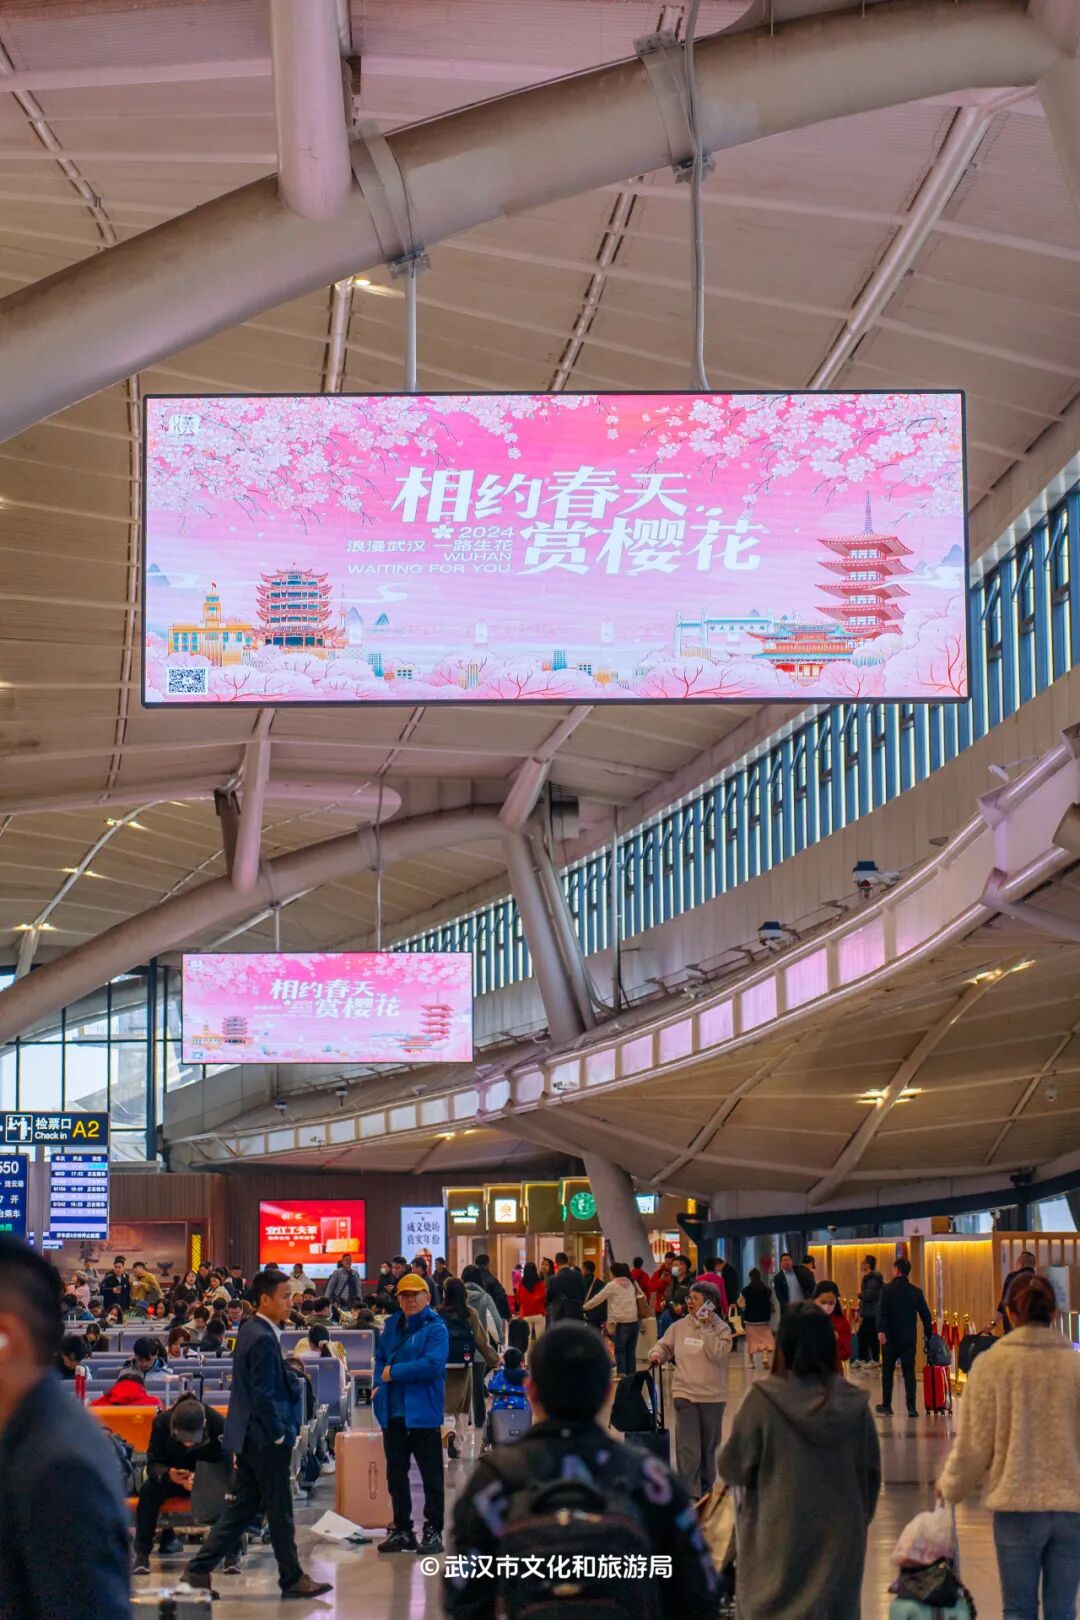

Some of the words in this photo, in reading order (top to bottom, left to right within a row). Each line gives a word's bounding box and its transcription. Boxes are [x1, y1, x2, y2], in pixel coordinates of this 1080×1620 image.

[391, 465, 688, 523] 相约春天
[459, 525, 515, 539] 2024
[347, 539, 426, 553] 浪漫武汉
[433, 539, 513, 553] 一路生花
[515, 507, 765, 576] 赏樱花
[443, 551, 512, 562] WUHAN
[347, 564, 423, 575] WAITING
[428, 564, 465, 574] FOR
[471, 563, 512, 574] YOU
[270, 979, 376, 1000] 相约春天
[315, 992, 401, 1019] 赏樱花
[35, 1117, 72, 1130] 检票口
[72, 1120, 100, 1139] A2
[9, 1195, 20, 1204] 开
